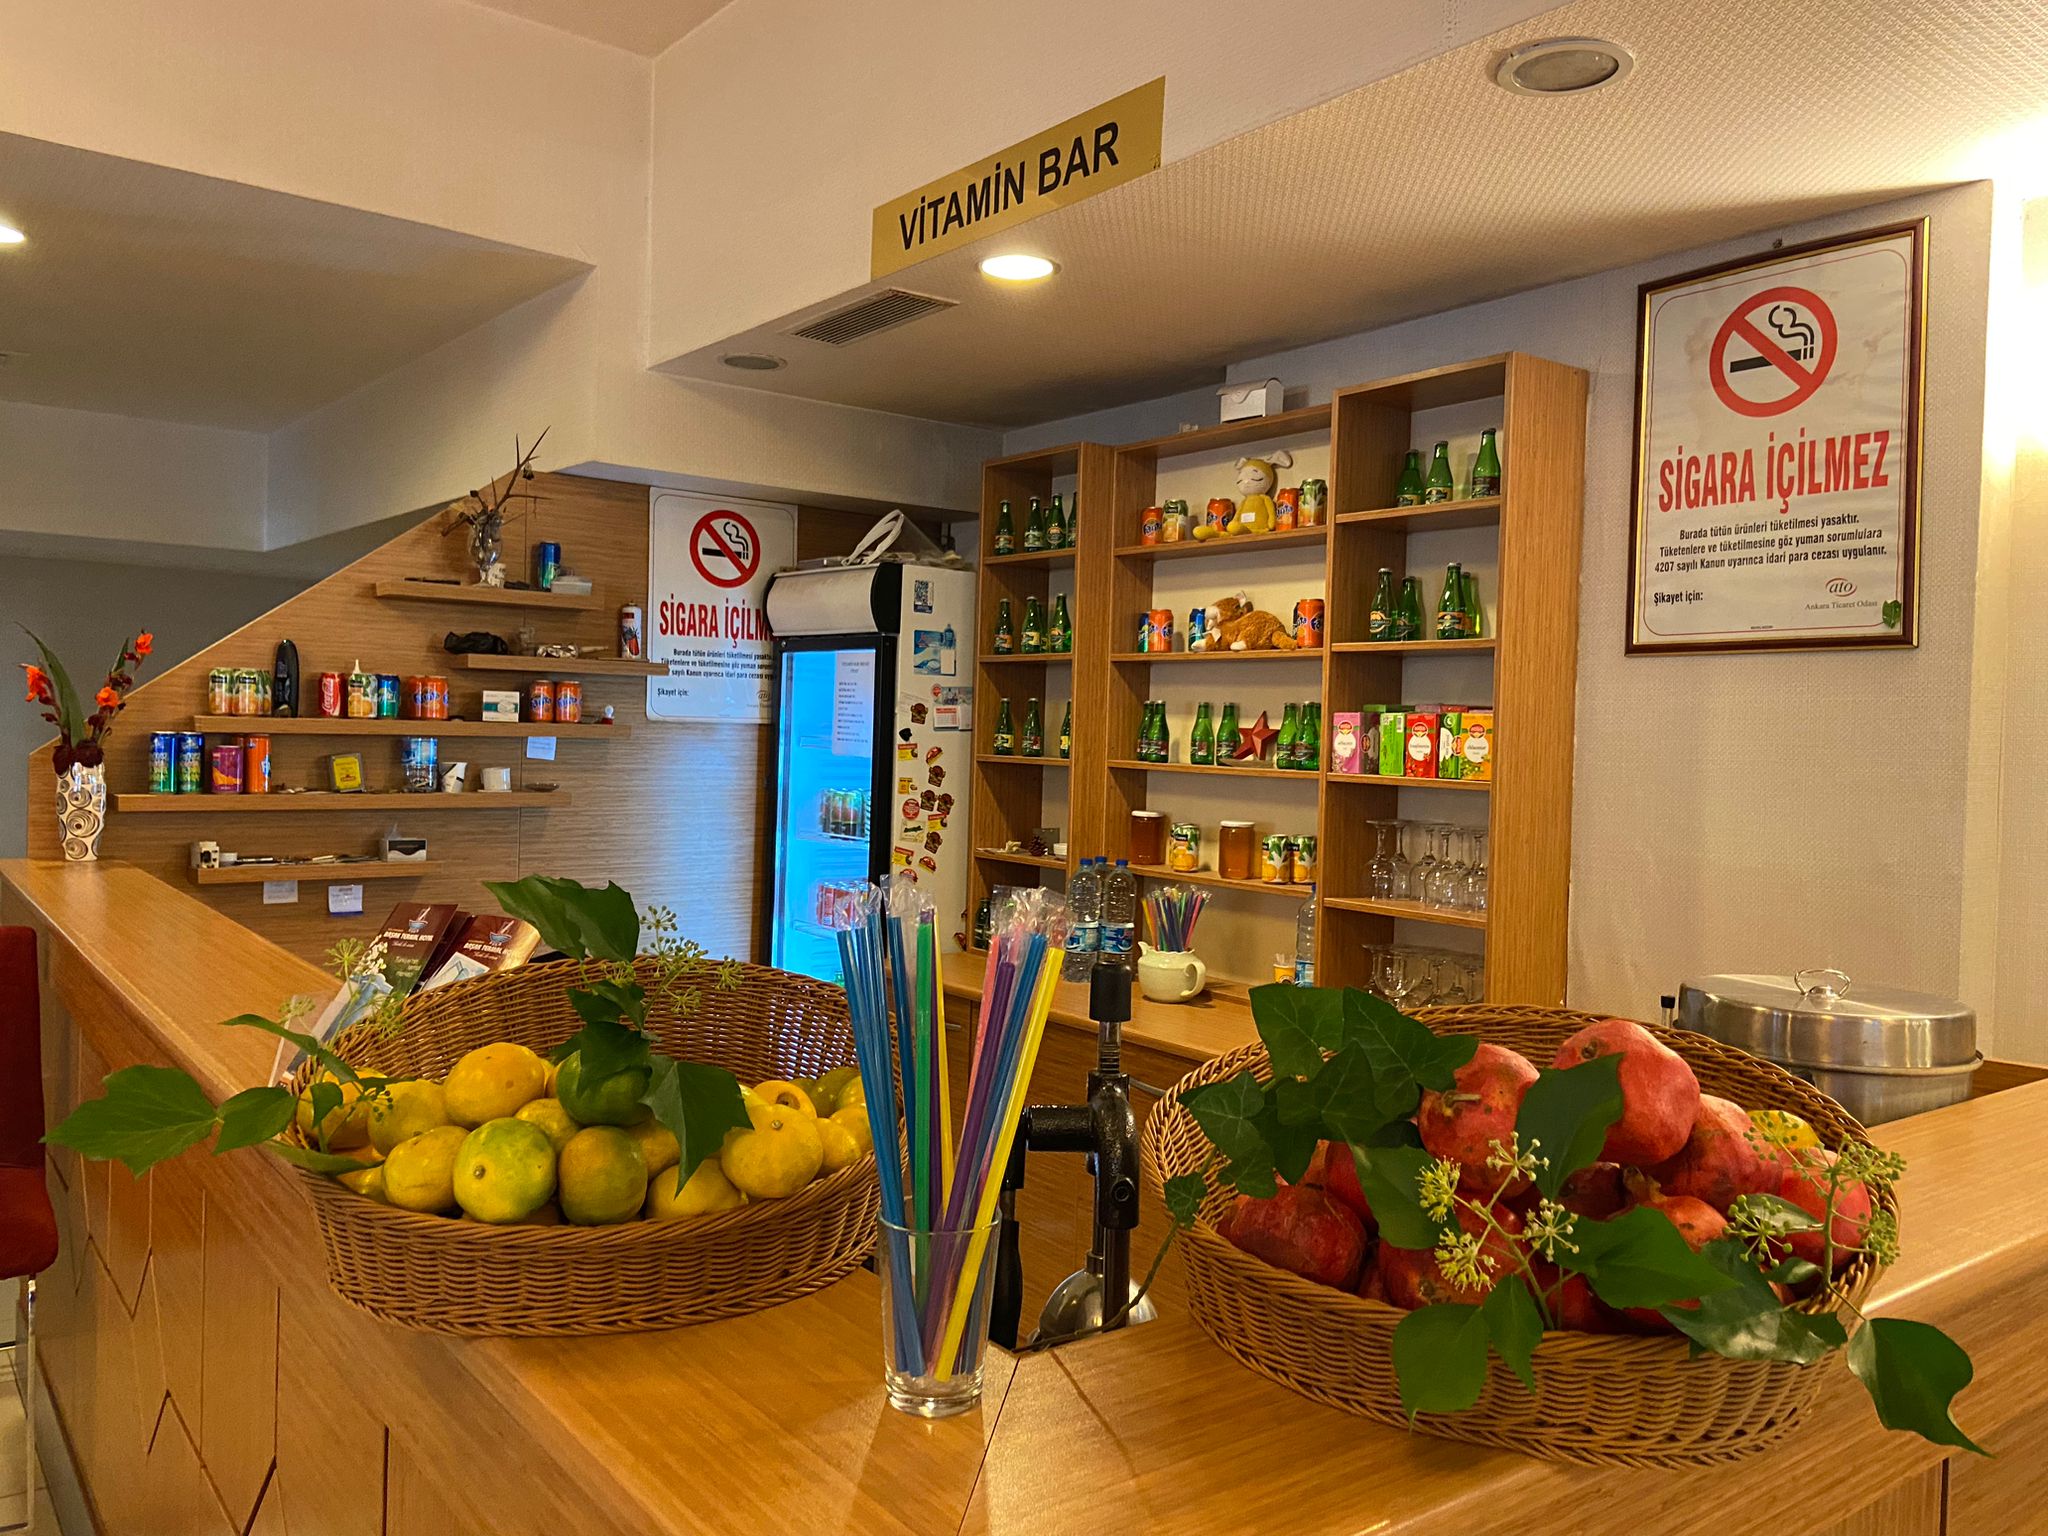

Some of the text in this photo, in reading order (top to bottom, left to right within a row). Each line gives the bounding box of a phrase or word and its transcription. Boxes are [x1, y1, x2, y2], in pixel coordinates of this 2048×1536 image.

[899, 122, 1119, 250] VİTAMİN BAR
[1659, 427, 1890, 514] SİGARA İÇİLMEZ
[1680, 513, 1860, 540] Burada tütün ürünleri tüketilmesi yasaktır.
[1660, 528, 1882, 557] Tüketenlere ve tüketilmesine göz yuman sorumlulara
[1655, 545, 1887, 573] 4207 sayılı Kanun uyarınca idari para cezası uygulanır.
[1653, 590, 1703, 606] Şikayet için:
[660, 593, 719, 638] SİGARA
